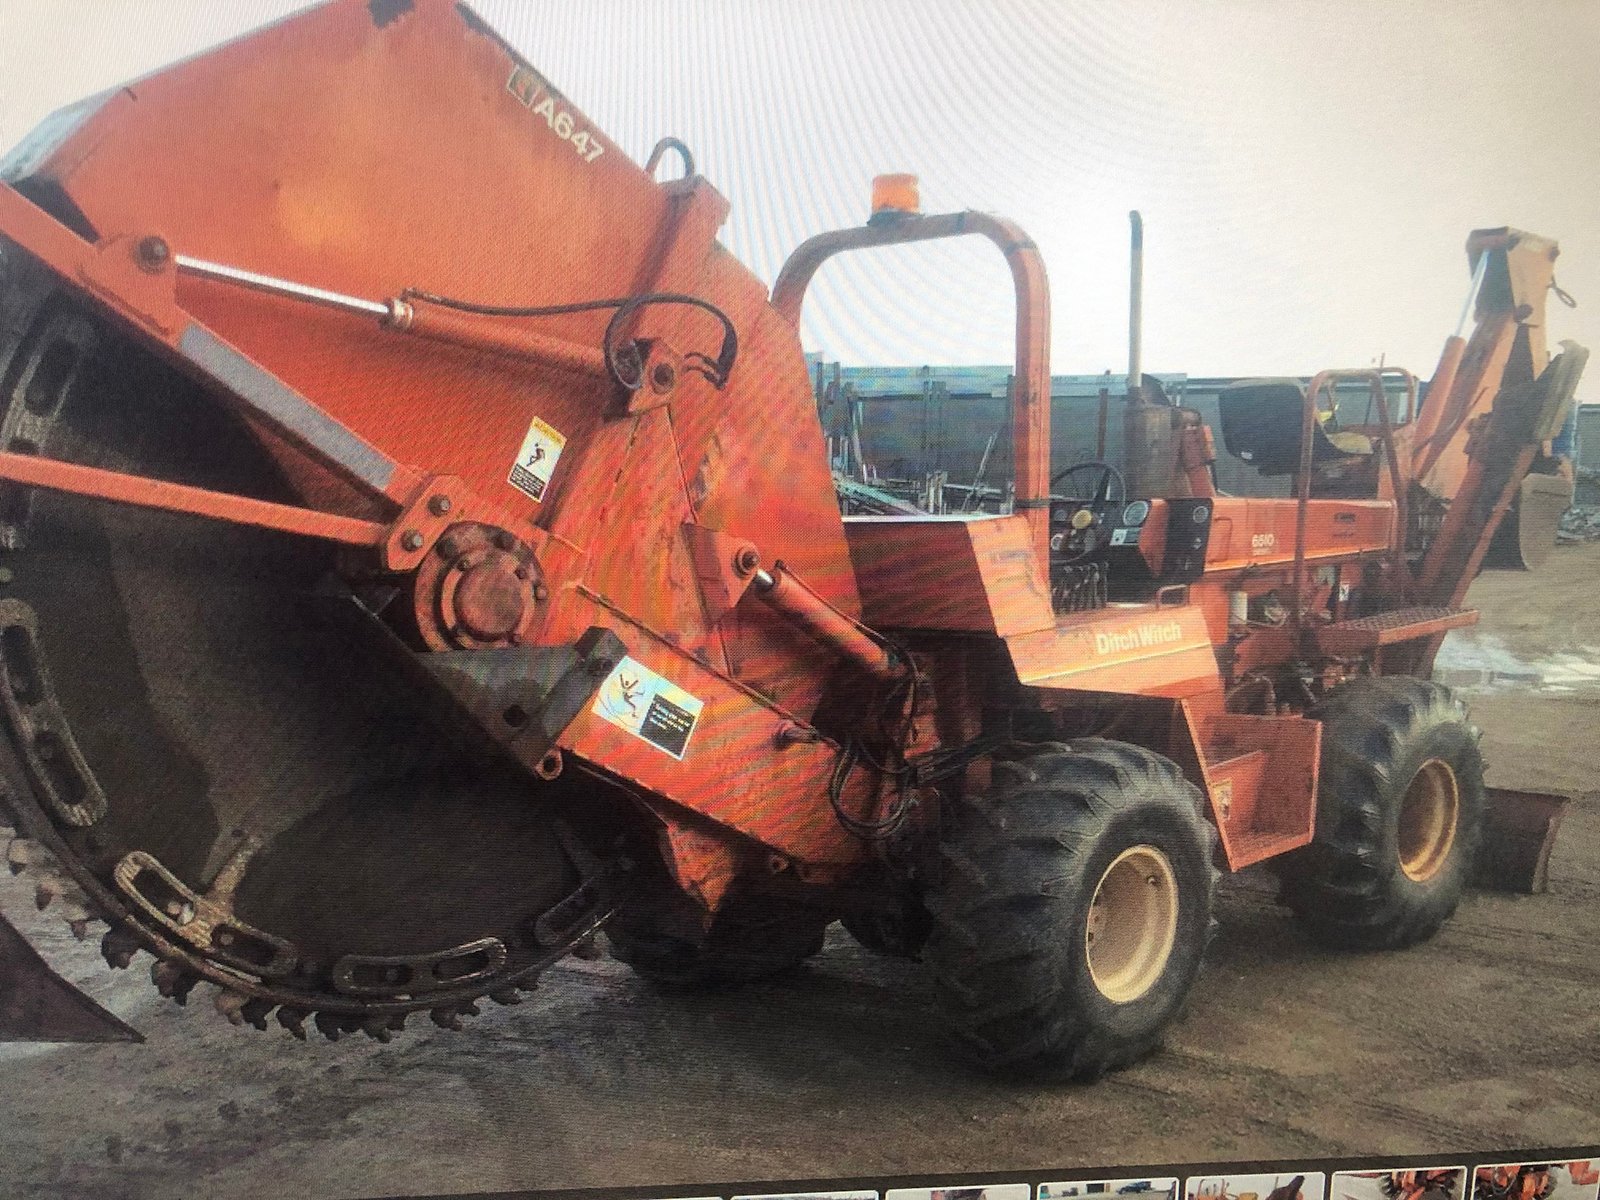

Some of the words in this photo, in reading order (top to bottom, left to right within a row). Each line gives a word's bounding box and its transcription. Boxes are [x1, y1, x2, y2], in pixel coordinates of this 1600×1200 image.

[532, 98, 604, 163] A647
[1095, 629, 1140, 655] Ditch
[1138, 622, 1182, 647] Witch
